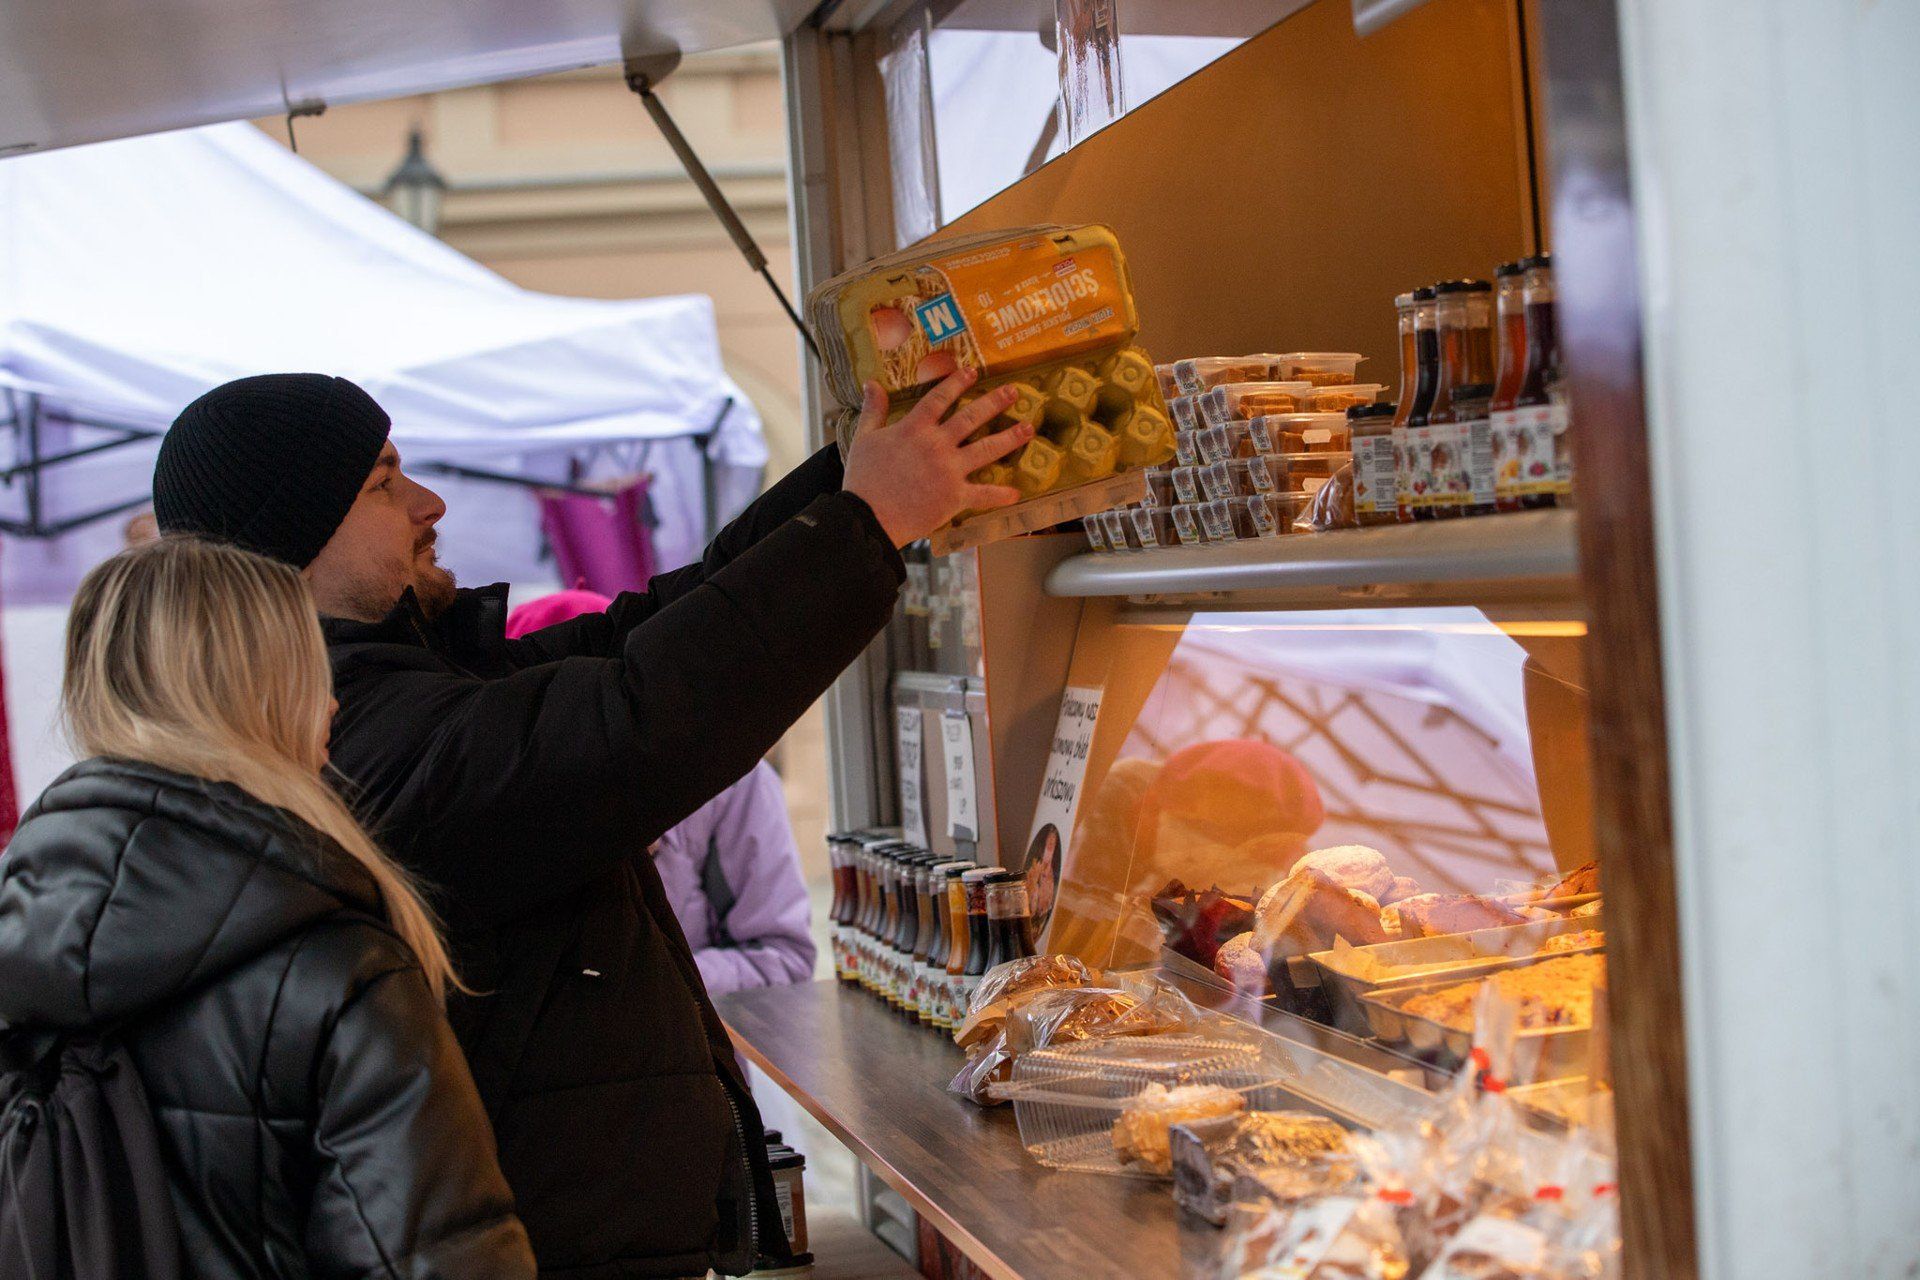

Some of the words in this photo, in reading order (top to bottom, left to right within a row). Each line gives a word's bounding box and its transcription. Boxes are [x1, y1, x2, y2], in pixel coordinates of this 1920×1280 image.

[978, 291, 993, 308] 10
[986, 268, 1100, 335] ŚCIÓŁKOWE
[924, 302, 957, 336] M
[1041, 312, 1071, 329] POLSKIE
